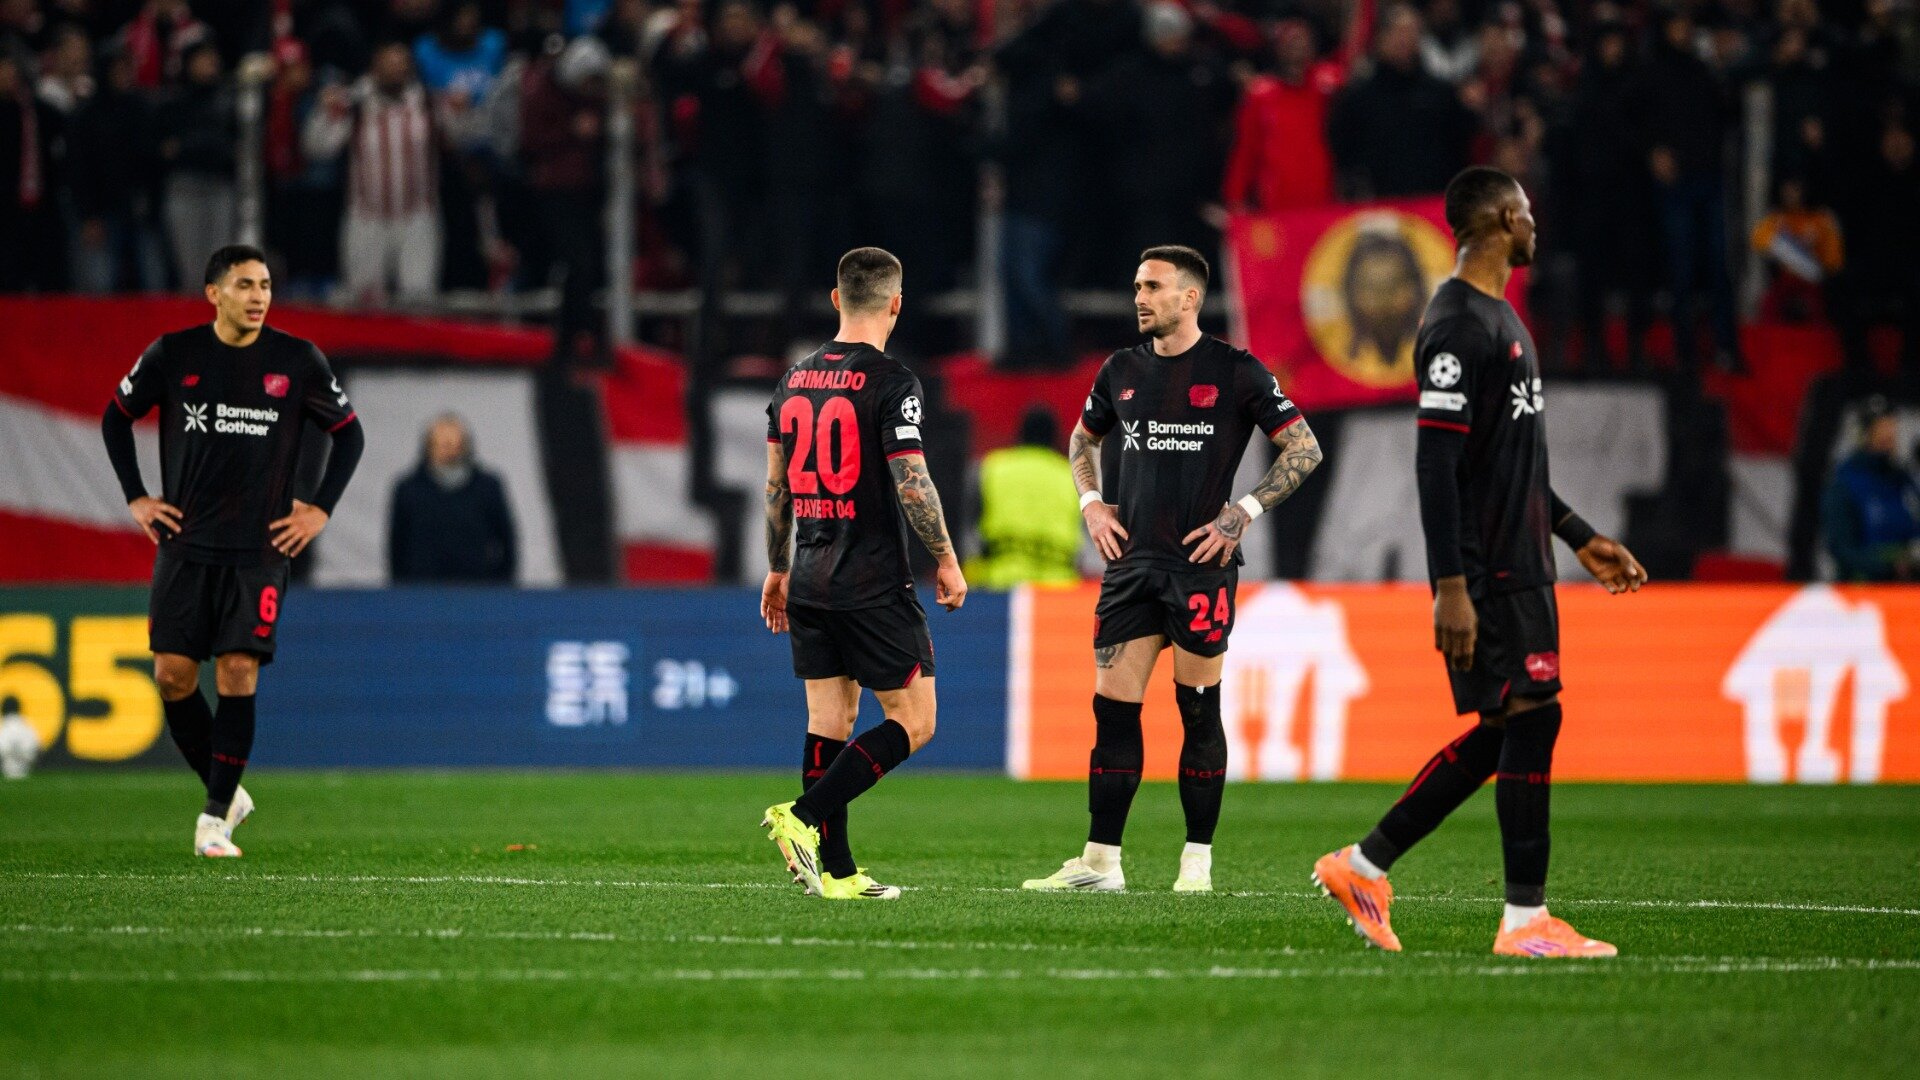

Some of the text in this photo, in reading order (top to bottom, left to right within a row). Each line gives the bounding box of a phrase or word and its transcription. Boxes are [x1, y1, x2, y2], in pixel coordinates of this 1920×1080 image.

[787, 370, 867, 391] GRIMALDO
[216, 403, 279, 422] Barmenia
[214, 419, 270, 436] Gothaer
[1148, 420, 1214, 435] Barmenia
[779, 395, 861, 495] 20
[1147, 437, 1204, 451] Gothaer
[793, 498, 856, 519] BAYER 04
[259, 585, 279, 623] 6
[1188, 587, 1230, 632] 24
